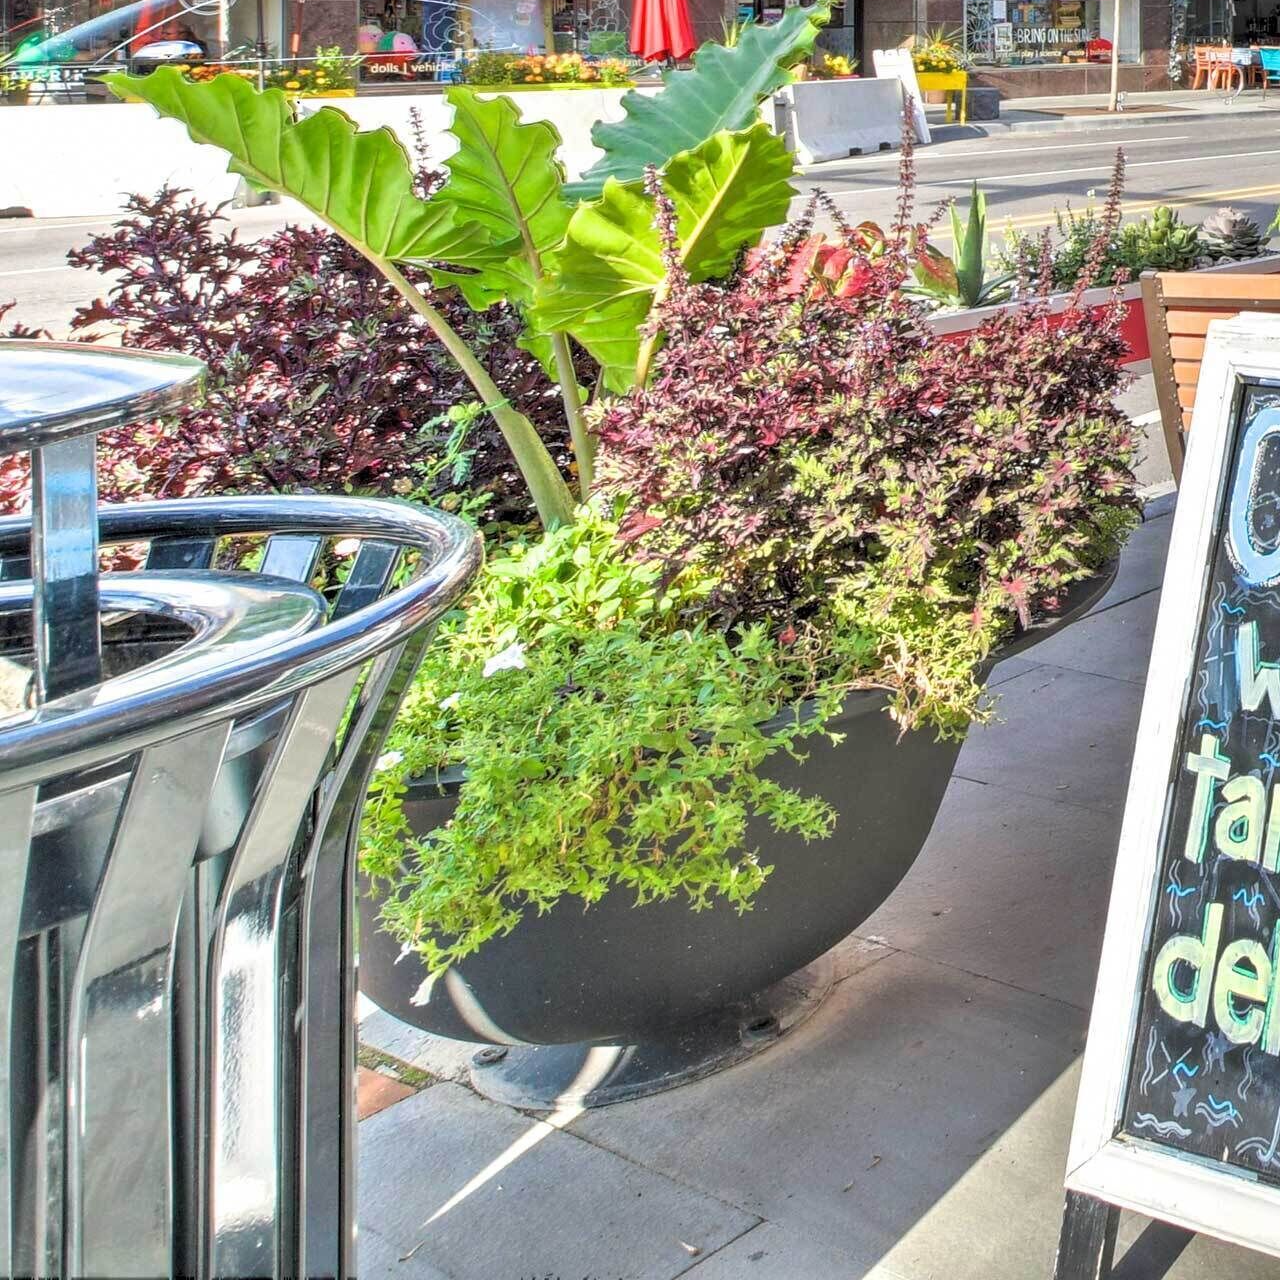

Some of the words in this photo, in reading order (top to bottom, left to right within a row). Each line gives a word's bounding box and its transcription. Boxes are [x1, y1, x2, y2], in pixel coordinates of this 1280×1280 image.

[1017, 28, 1047, 43] BRING
[1047, 28, 1059, 44] ON
[1060, 29, 1074, 42] THE
[370, 62, 399, 73] dolls
[411, 62, 457, 72] vehicles
[10, 69, 85, 82] AMERIK
